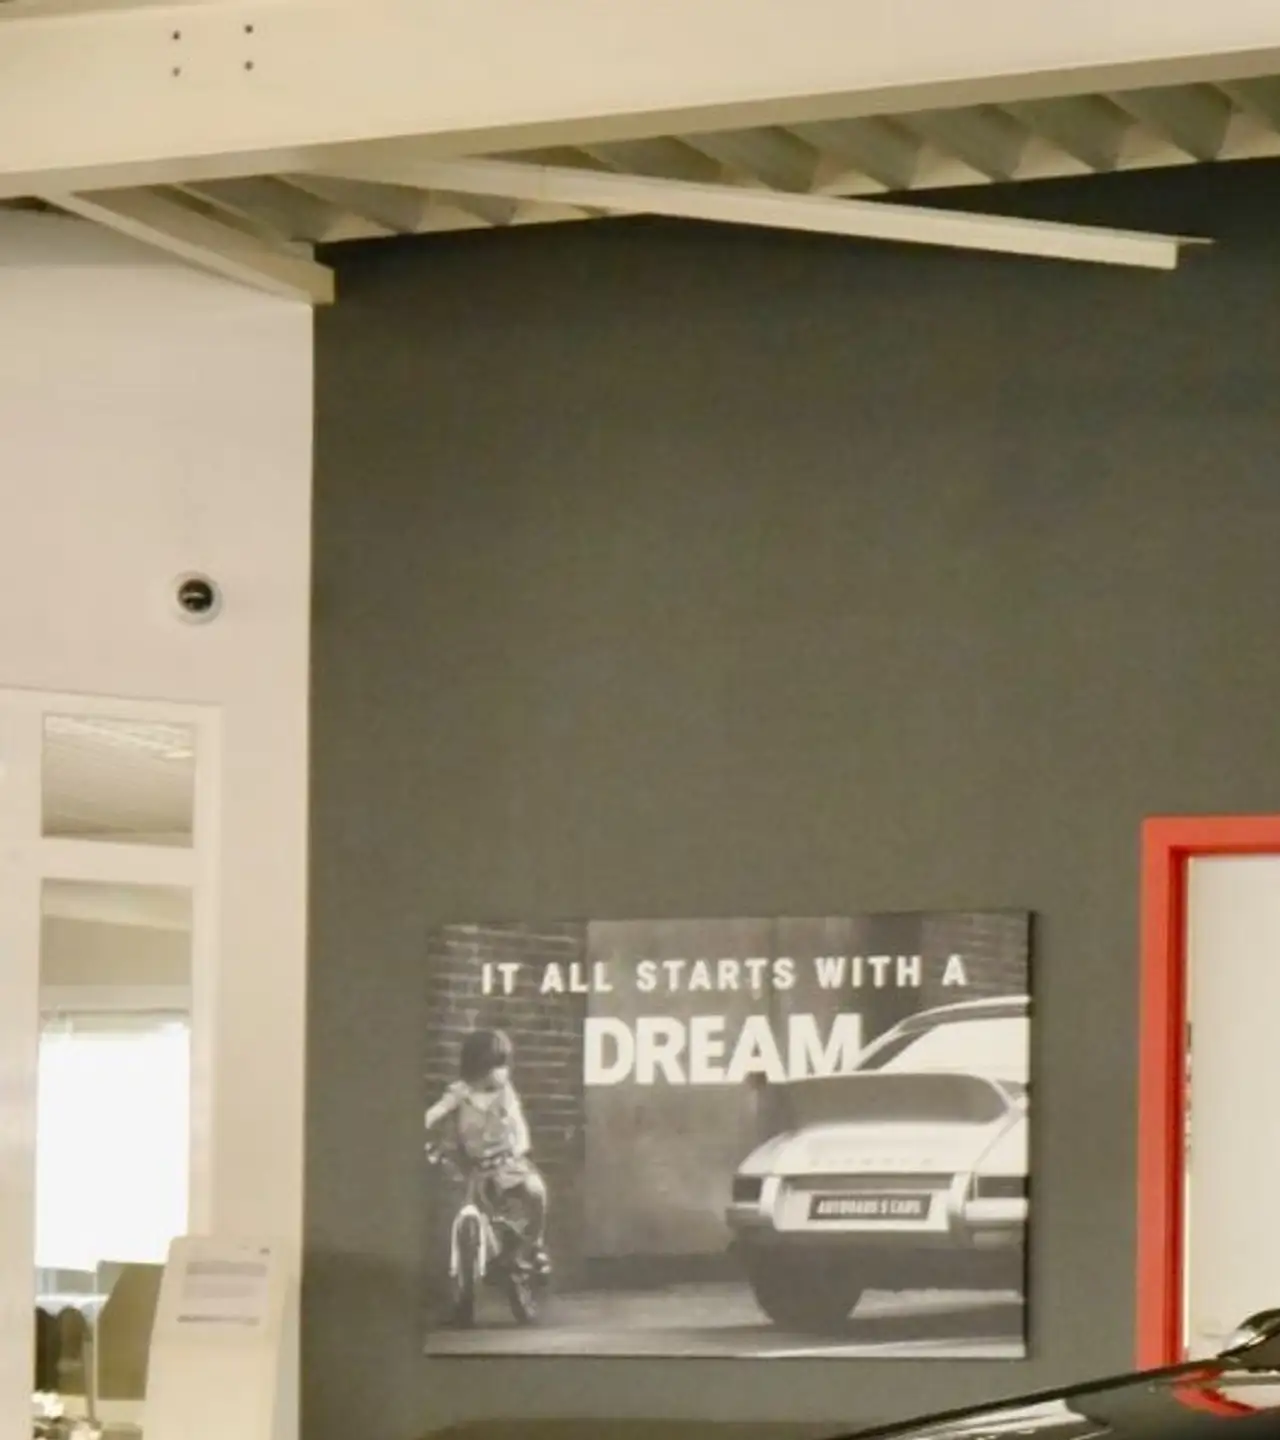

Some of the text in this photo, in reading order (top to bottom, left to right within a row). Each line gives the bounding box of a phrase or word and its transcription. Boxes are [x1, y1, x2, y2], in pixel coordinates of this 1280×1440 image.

[481, 953, 969, 995] IT ALL STARTS WITH A
[583, 1012, 863, 1087] DREAM
